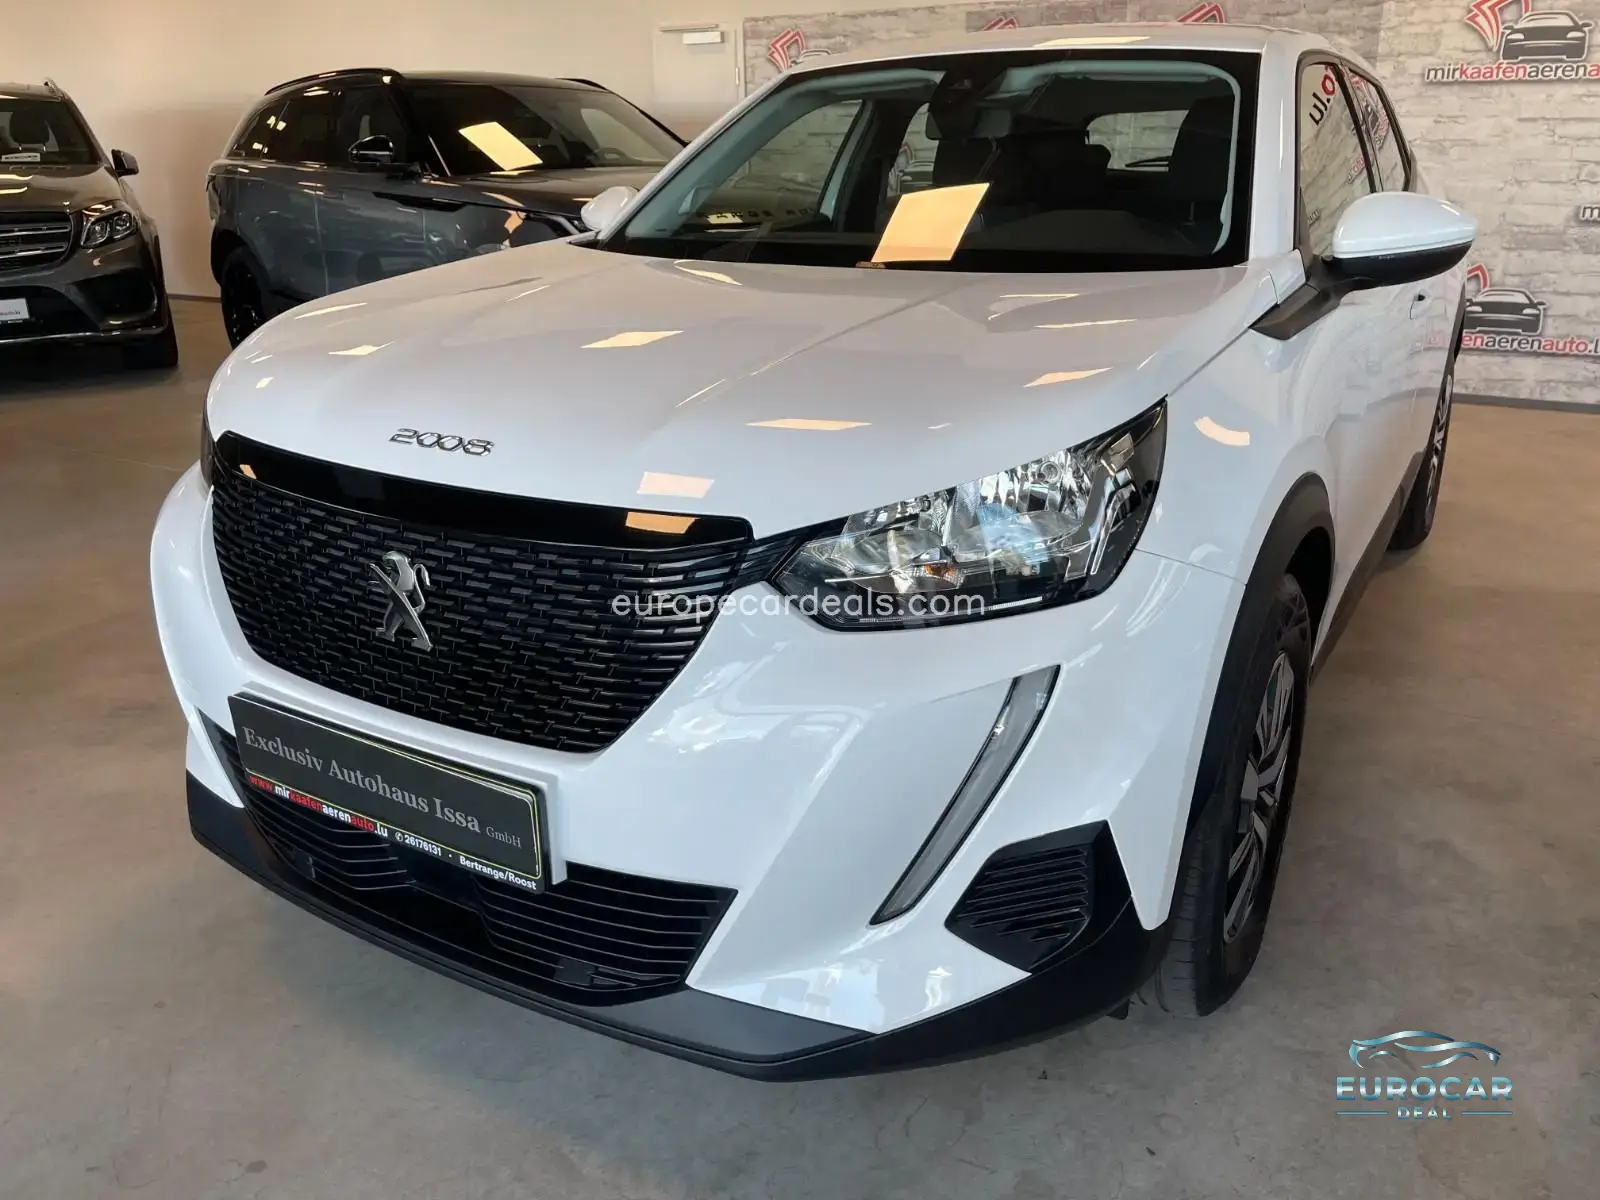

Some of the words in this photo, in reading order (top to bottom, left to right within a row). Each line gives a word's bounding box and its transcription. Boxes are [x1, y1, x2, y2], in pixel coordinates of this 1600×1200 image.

[388, 428, 495, 456] 2008
[243, 726, 323, 772] Exclusiv
[328, 759, 429, 813] Autohaus
[433, 797, 481, 833] Issa
[486, 825, 522, 849] GmbH
[404, 834, 442, 857] 26176131
[459, 855, 537, 890] Bertrange/Roost
